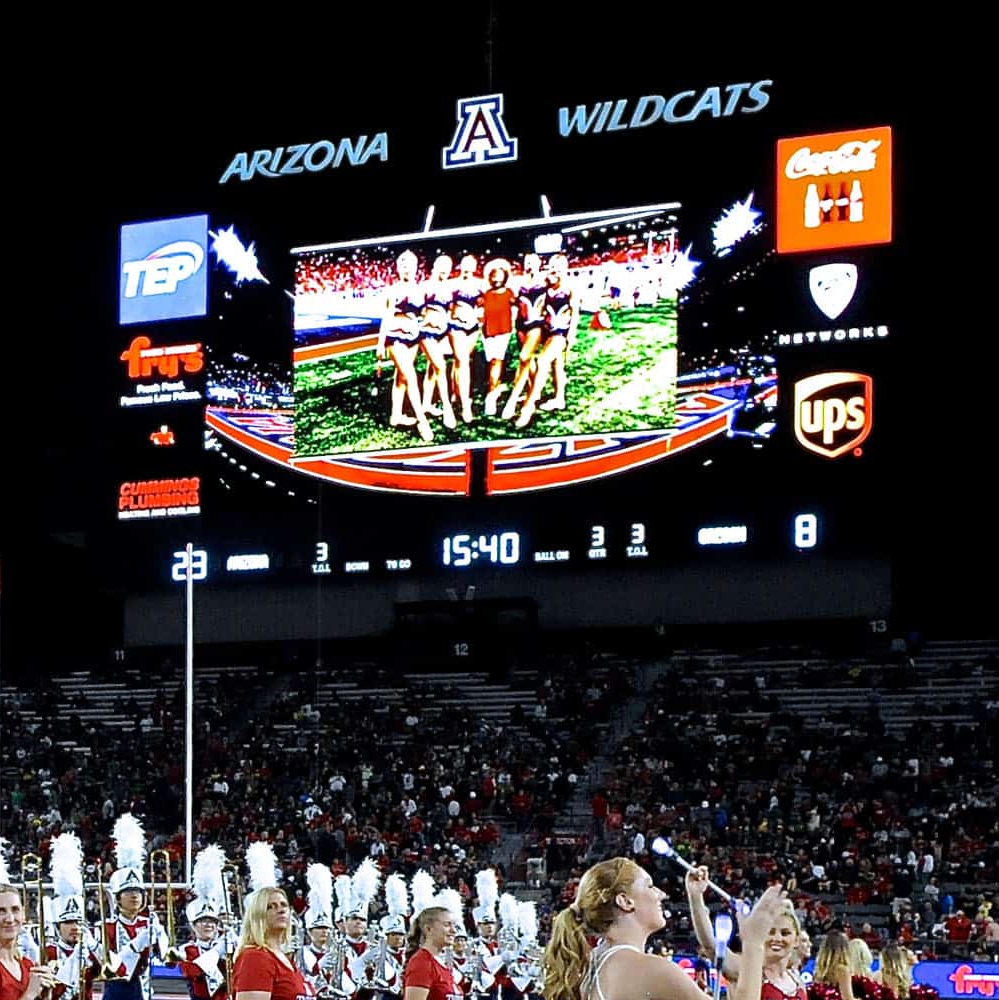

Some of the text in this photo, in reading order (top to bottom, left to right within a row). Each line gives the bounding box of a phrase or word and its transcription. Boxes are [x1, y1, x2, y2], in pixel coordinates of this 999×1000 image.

[558, 79, 774, 138] WILDCATS
[442, 93, 519, 170] A
[218, 132, 389, 184] ARIZONA
[122, 254, 197, 299] TEP
[778, 324, 890, 346] NETWORKS
[801, 396, 867, 445] ups
[118, 491, 200, 511] PLUMBING
[591, 525, 605, 547] 3
[631, 523, 646, 545] 3
[794, 513, 818, 548] 8
[315, 541, 329, 562] 3
[442, 531, 521, 567] 15:40
[171, 550, 208, 581] 23
[869, 620, 887, 633] 13
[454, 643, 469, 656] 12
